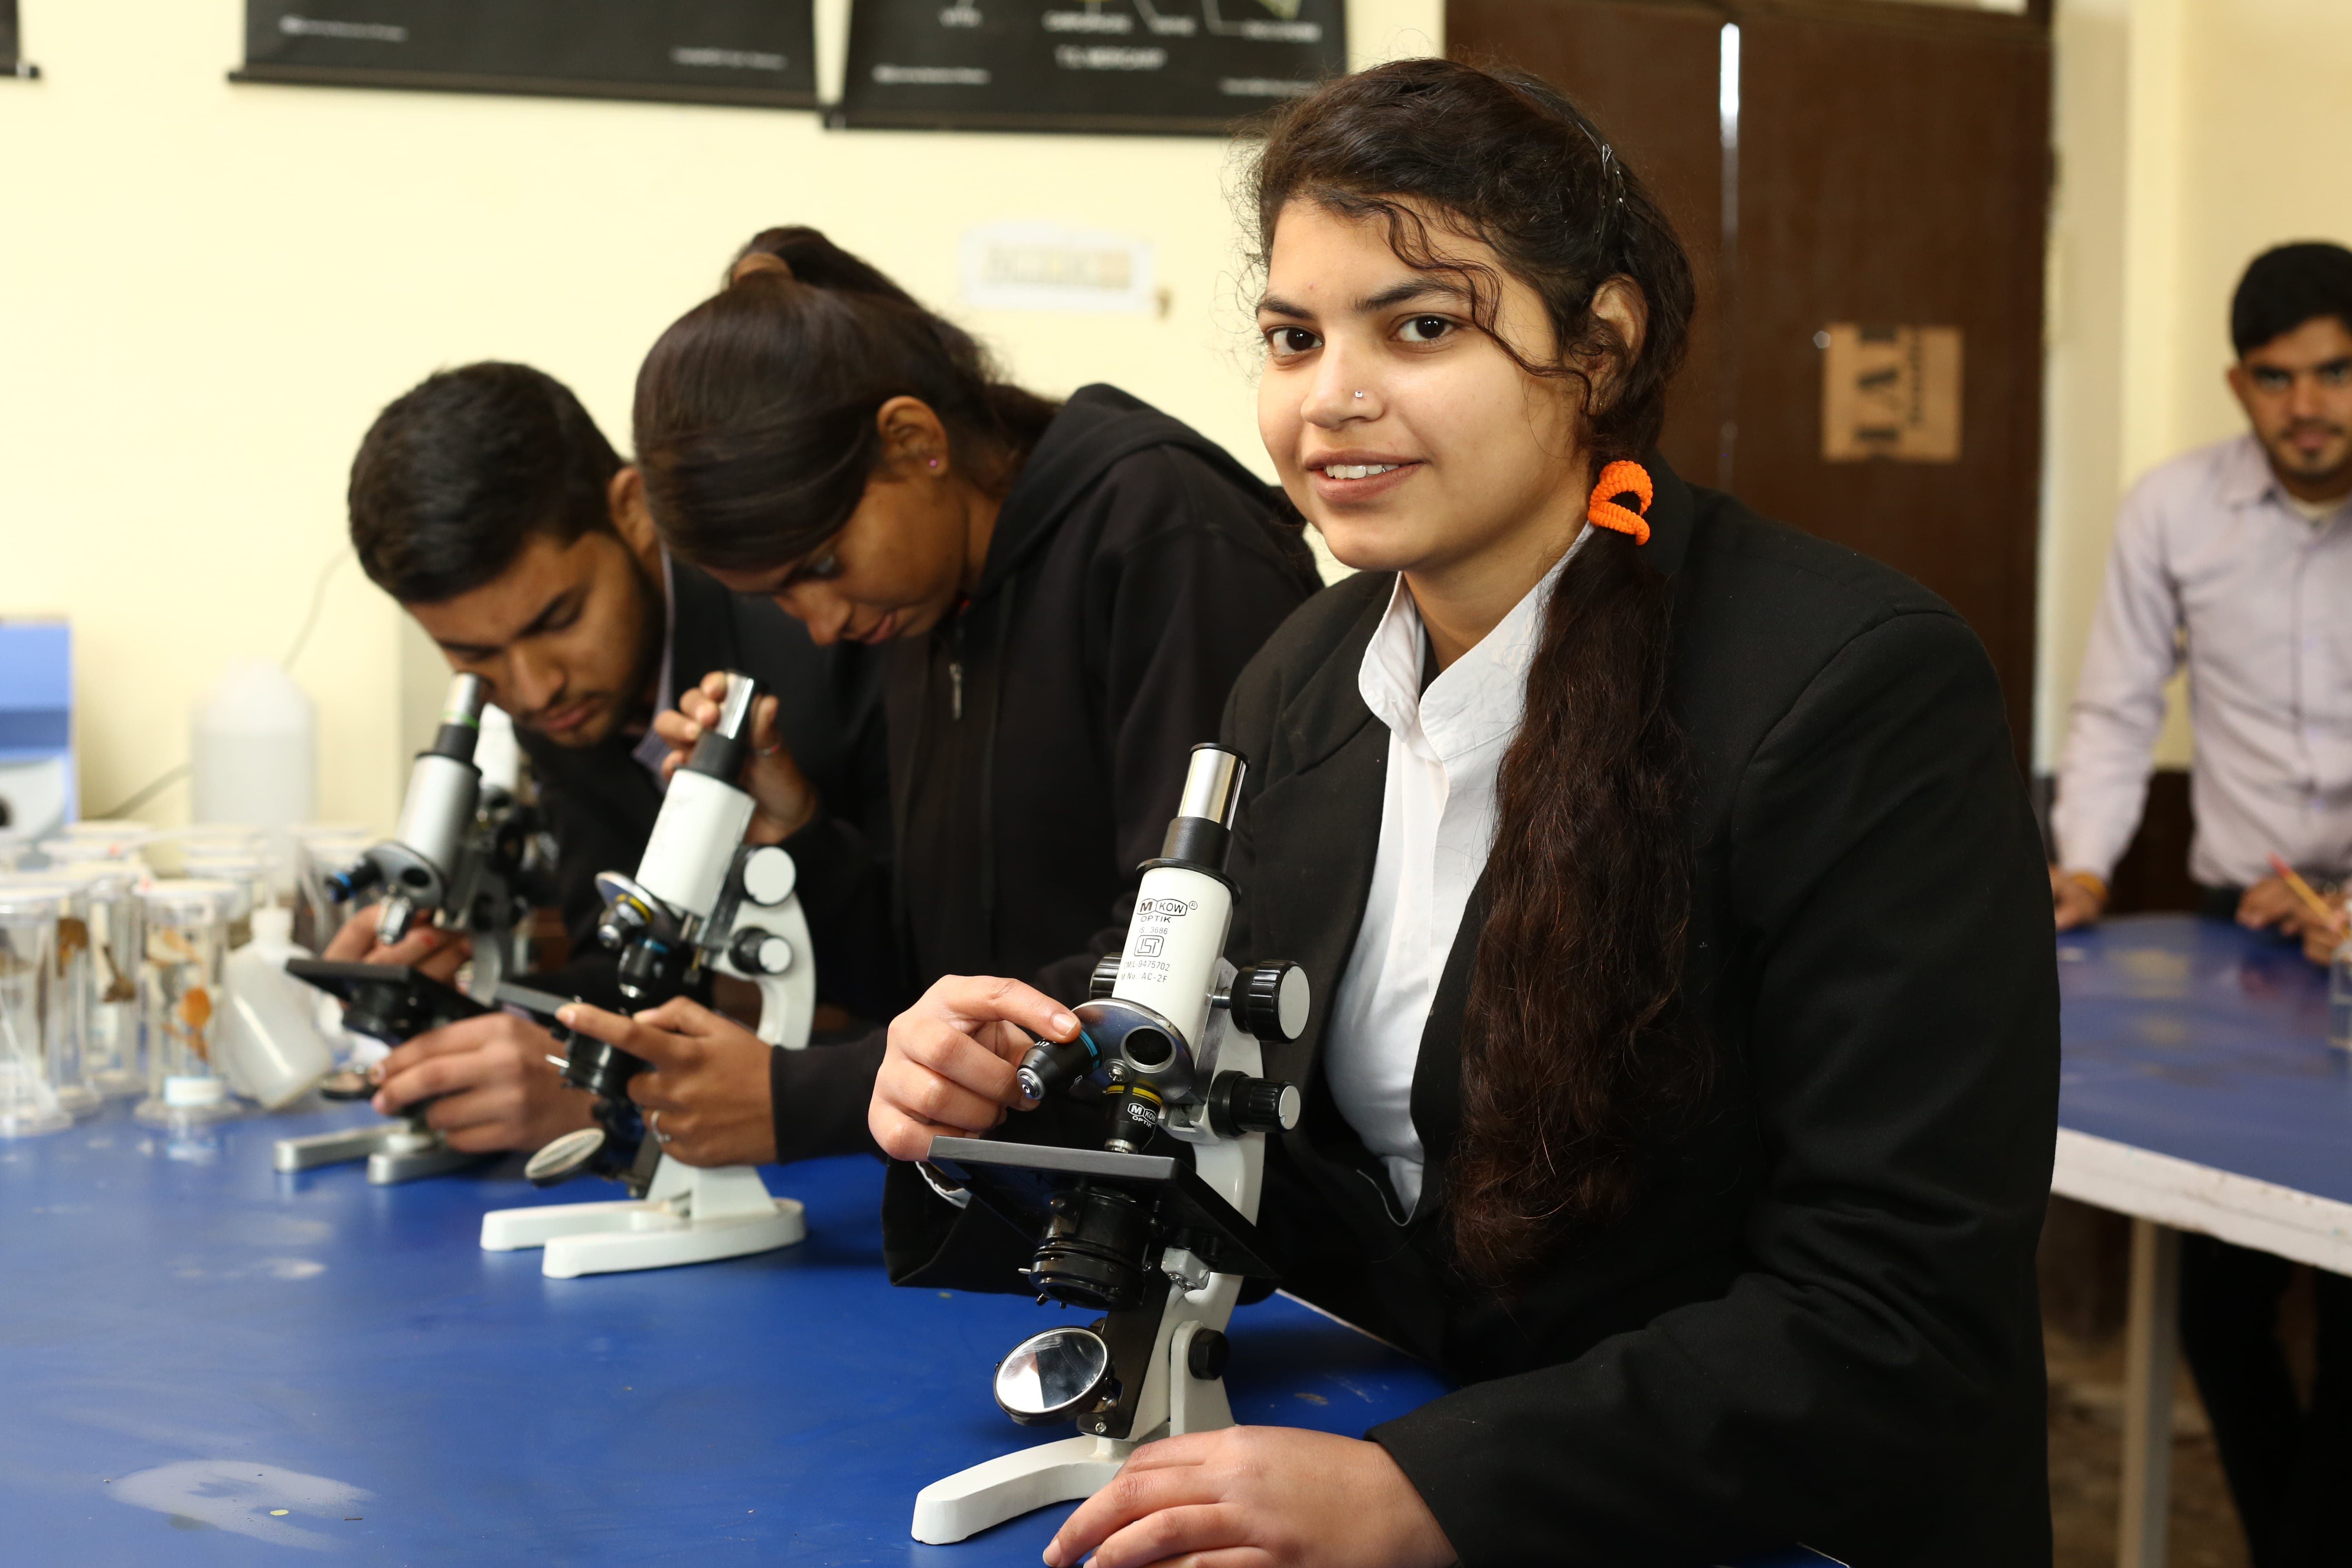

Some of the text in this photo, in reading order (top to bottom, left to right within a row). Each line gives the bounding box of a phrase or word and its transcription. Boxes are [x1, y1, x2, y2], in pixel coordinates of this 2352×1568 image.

[1159, 902, 1184, 913] KOW
[1150, 927, 1168, 935] 3686
[1132, 1116, 1152, 1128] OPTIK
